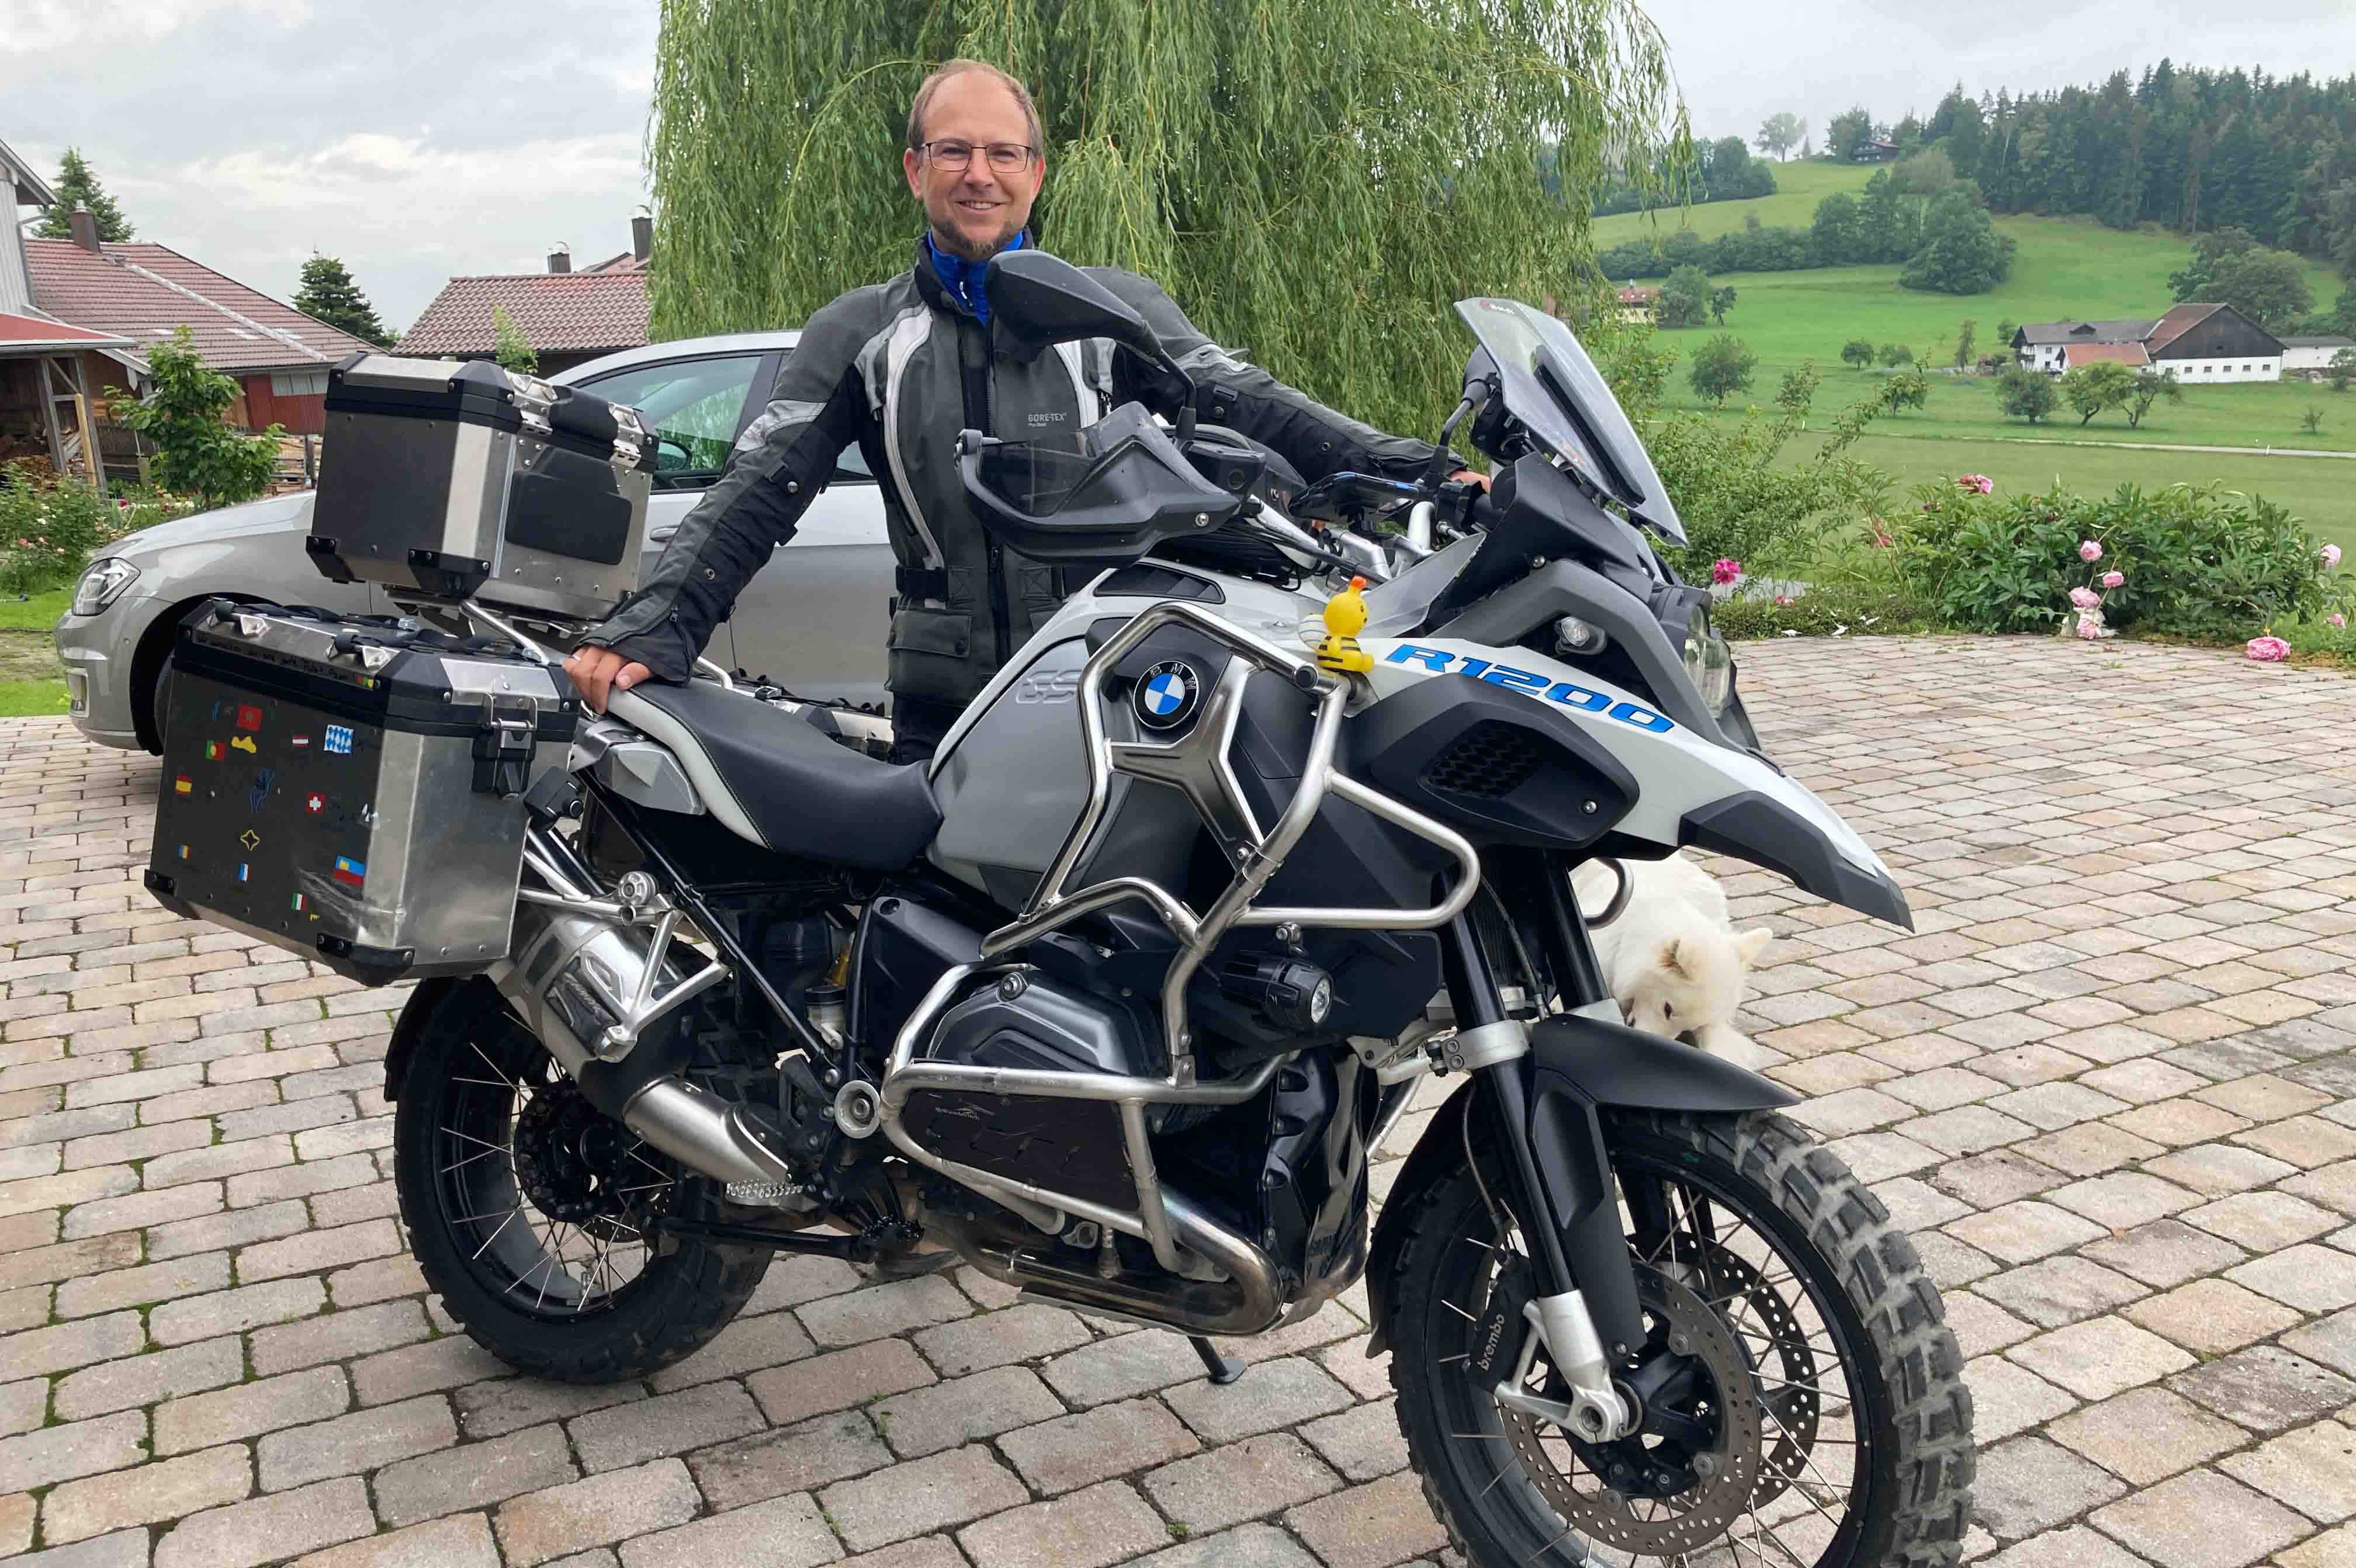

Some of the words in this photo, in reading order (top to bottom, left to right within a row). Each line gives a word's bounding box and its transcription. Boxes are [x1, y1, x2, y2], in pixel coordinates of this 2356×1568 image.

[1149, 662, 1197, 691] BMW
[1385, 644, 1674, 733] R1200
[1477, 1314, 1505, 1371] brembo
